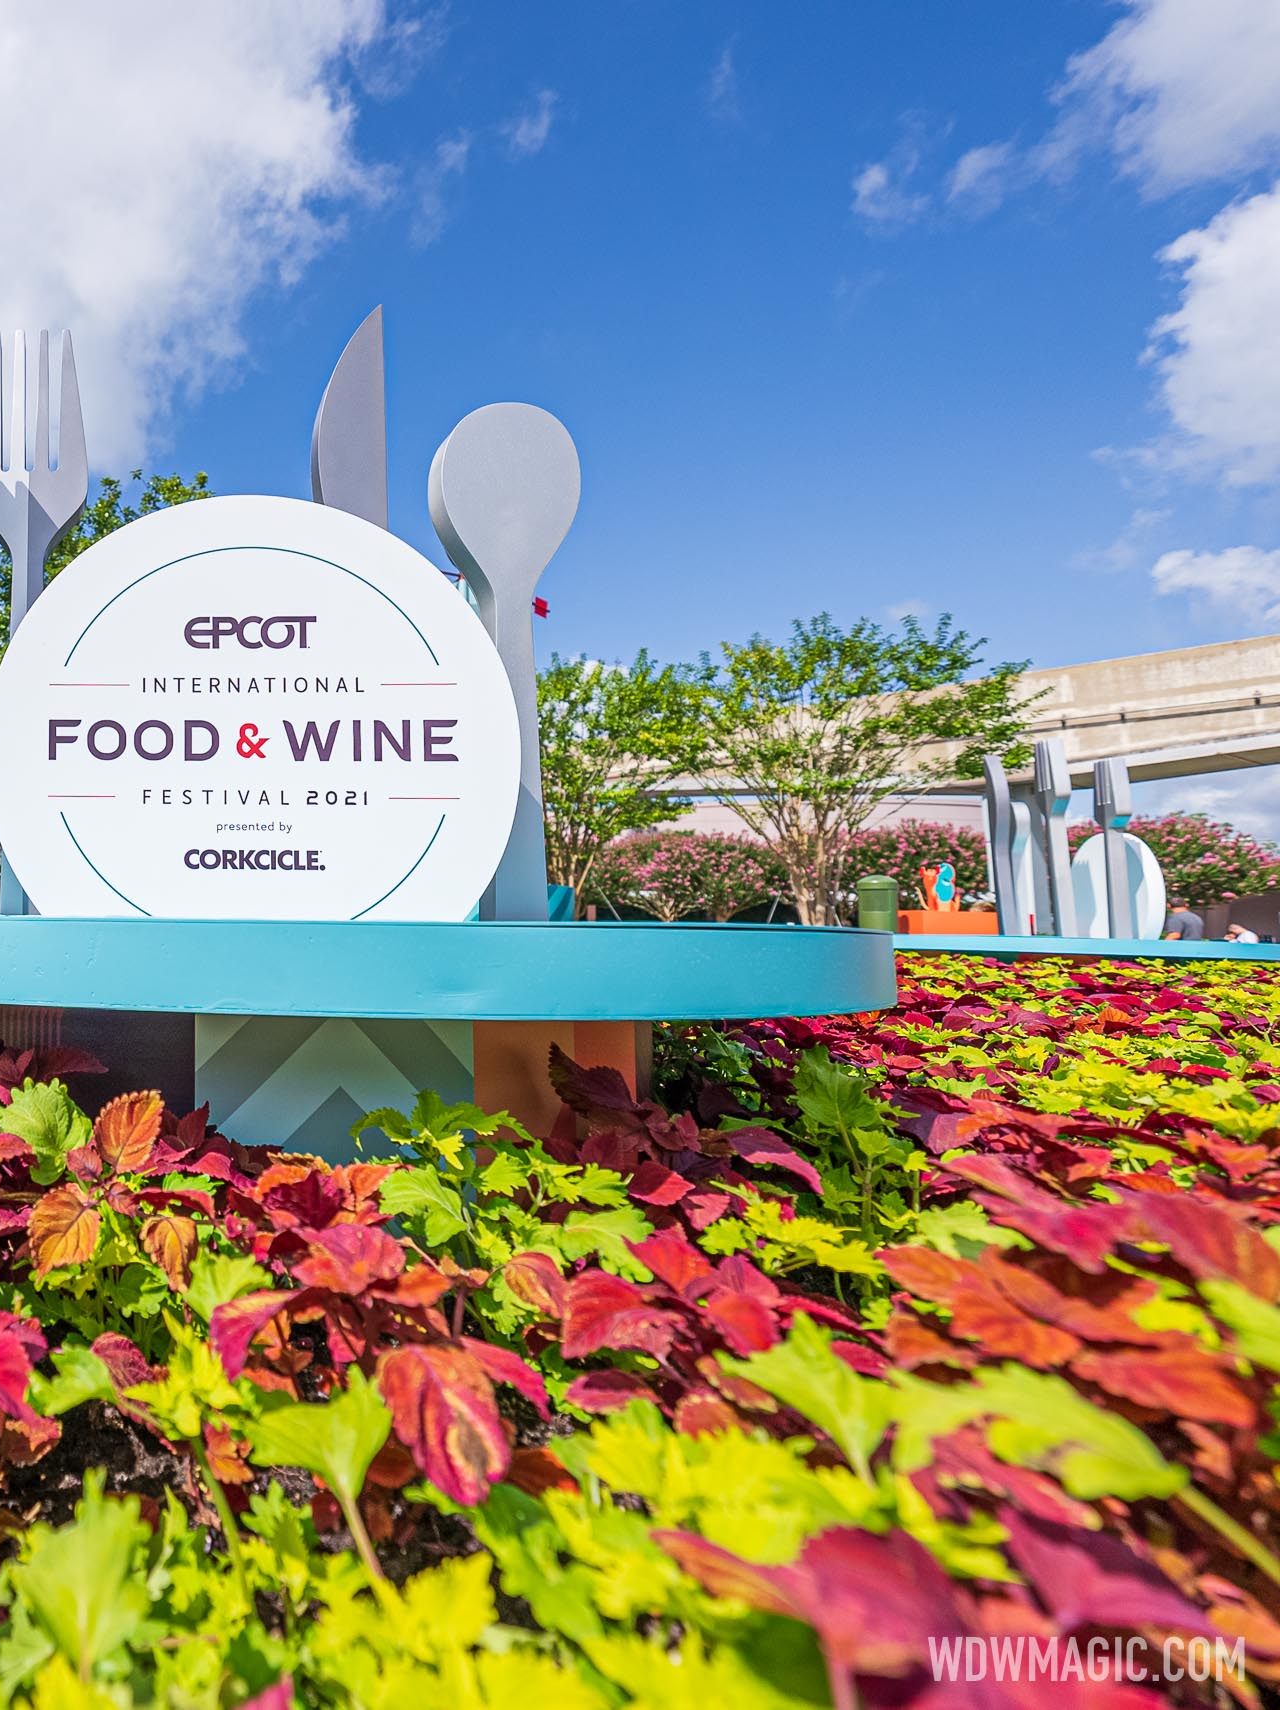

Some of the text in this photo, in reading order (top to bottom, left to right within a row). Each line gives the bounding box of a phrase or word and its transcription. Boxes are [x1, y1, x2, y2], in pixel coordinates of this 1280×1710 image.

[183, 615, 318, 650] EPCOT
[142, 676, 365, 694] INTERNATIONAL
[48, 719, 460, 763] FOOD & WINE
[142, 789, 369, 806] FESTIVAL 2021
[216, 821, 293, 834] presented by
